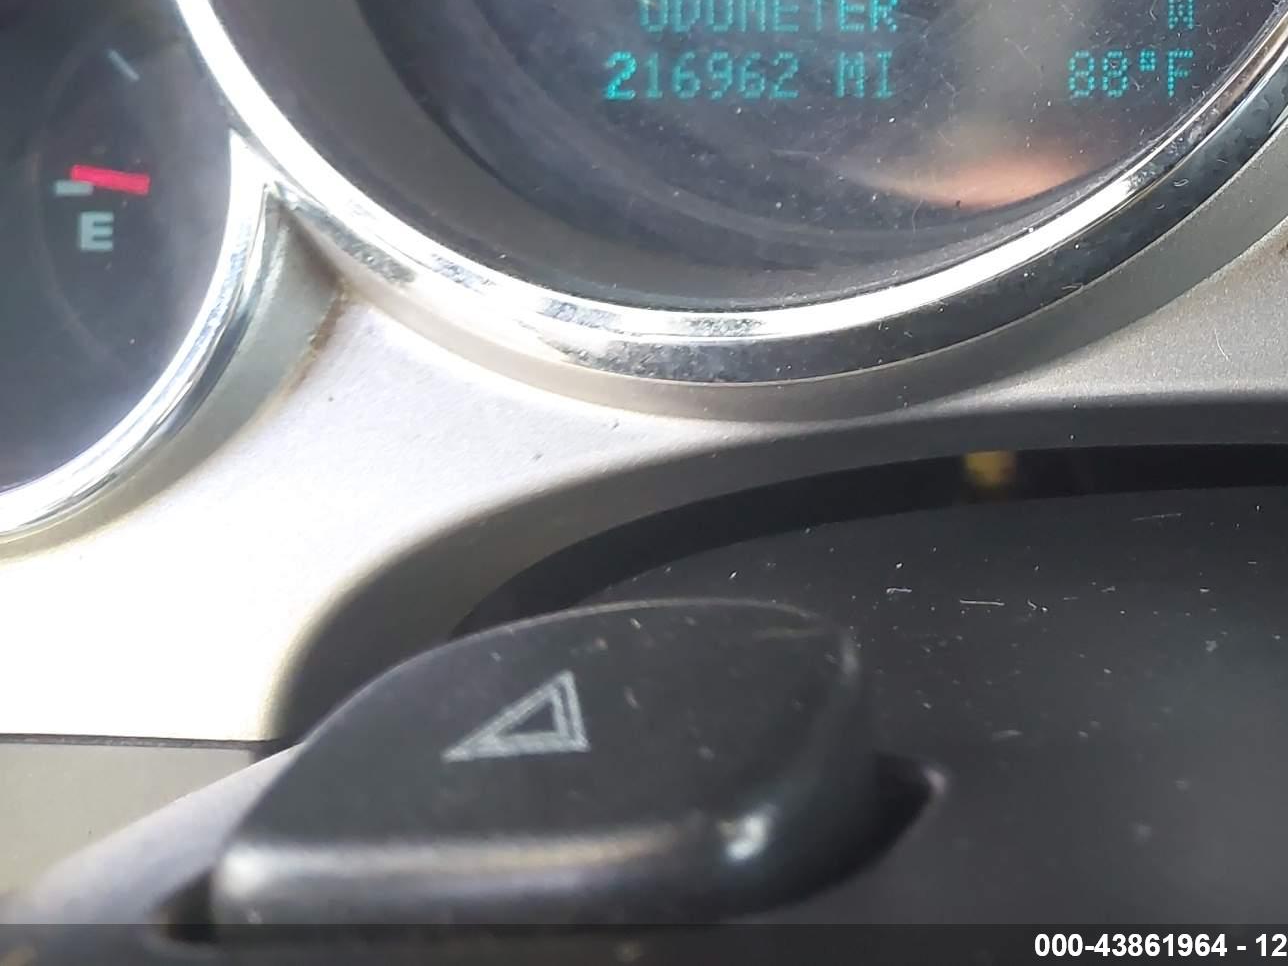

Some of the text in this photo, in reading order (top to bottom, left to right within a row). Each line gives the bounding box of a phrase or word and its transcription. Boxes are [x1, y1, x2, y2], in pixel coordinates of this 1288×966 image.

[603, 50, 894, 100] 216962 MI
[78, 212, 114, 251] E
